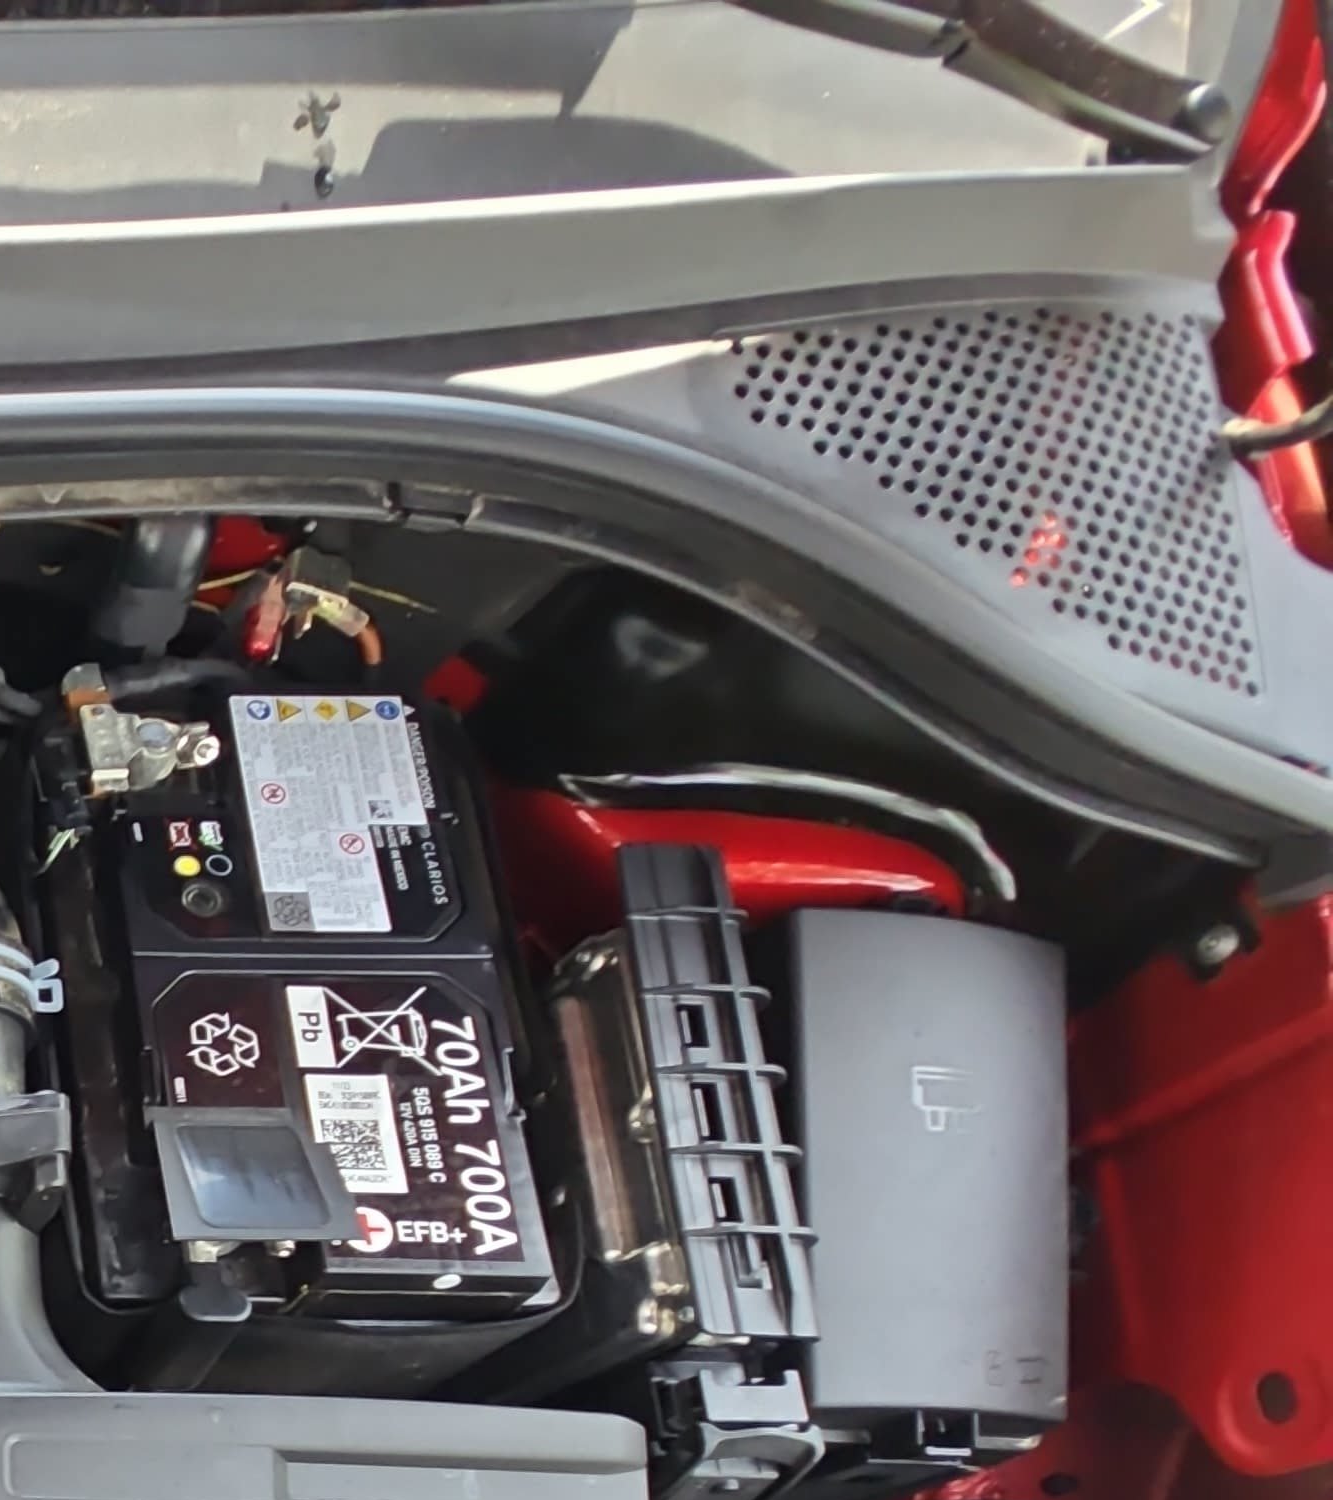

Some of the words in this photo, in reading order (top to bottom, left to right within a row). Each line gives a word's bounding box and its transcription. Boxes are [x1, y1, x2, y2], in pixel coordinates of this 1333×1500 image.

[393, 859, 409, 890] MEXICO
[421, 841, 450, 905] CLARIOS
[297, 1011, 323, 1043] Pb
[431, 1016, 490, 1123] 70Ah
[418, 1118, 439, 1142] 915
[409, 1146, 423, 1168] DIN
[428, 1171, 447, 1183] C
[454, 1139, 518, 1256] 700A
[395, 1219, 468, 1243] EFB+
